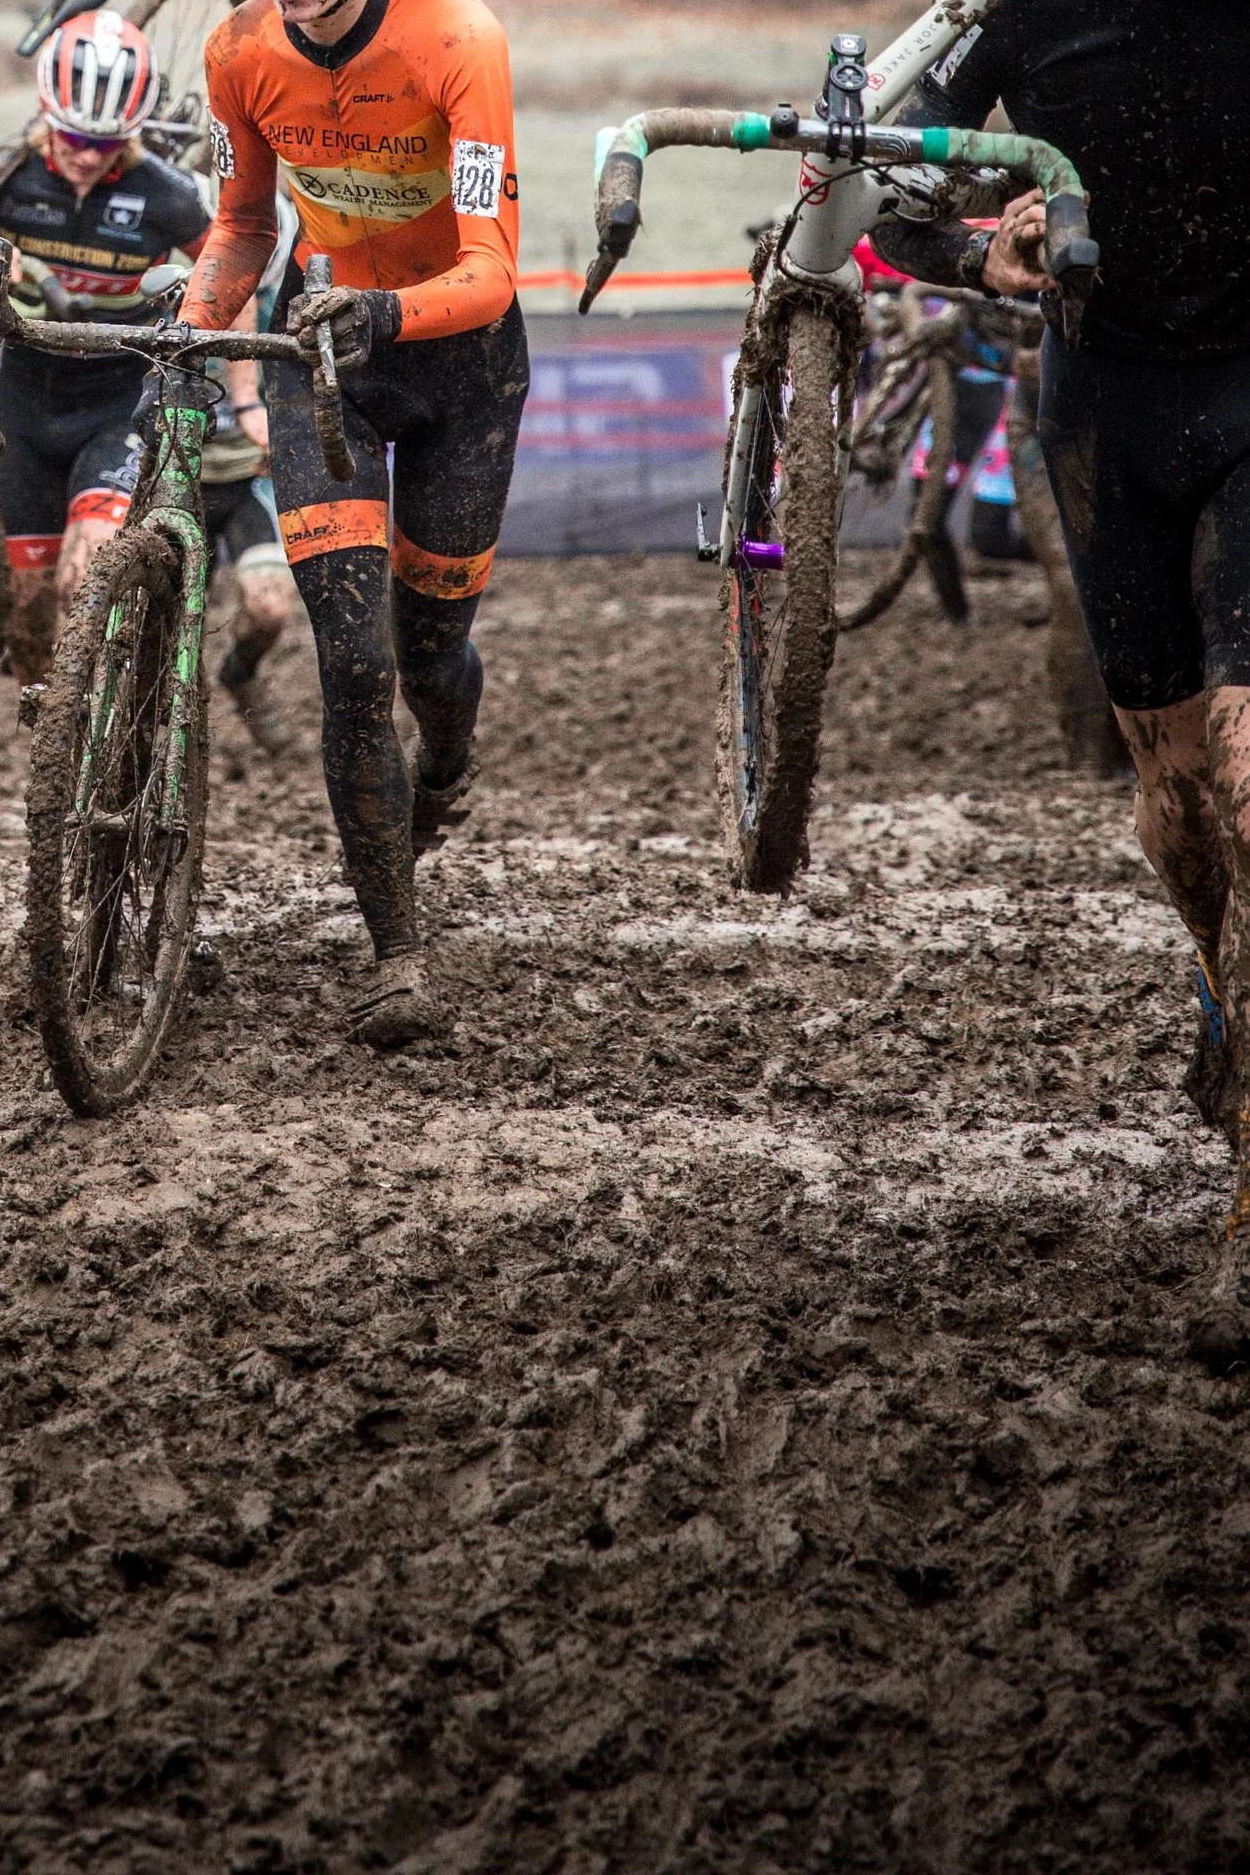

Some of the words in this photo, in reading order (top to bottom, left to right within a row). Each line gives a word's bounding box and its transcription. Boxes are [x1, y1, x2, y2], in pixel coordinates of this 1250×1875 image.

[883, 47, 912, 74] JAKE
[353, 94, 386, 103] CRAFT
[268, 124, 315, 146] NEW
[322, 129, 427, 155] ENGLAND
[285, 145, 430, 166] EVELOPMENT
[327, 182, 431, 201] CADENCE
[456, 164, 495, 210] 128
[369, 198, 433, 208] MANAGEMENT
